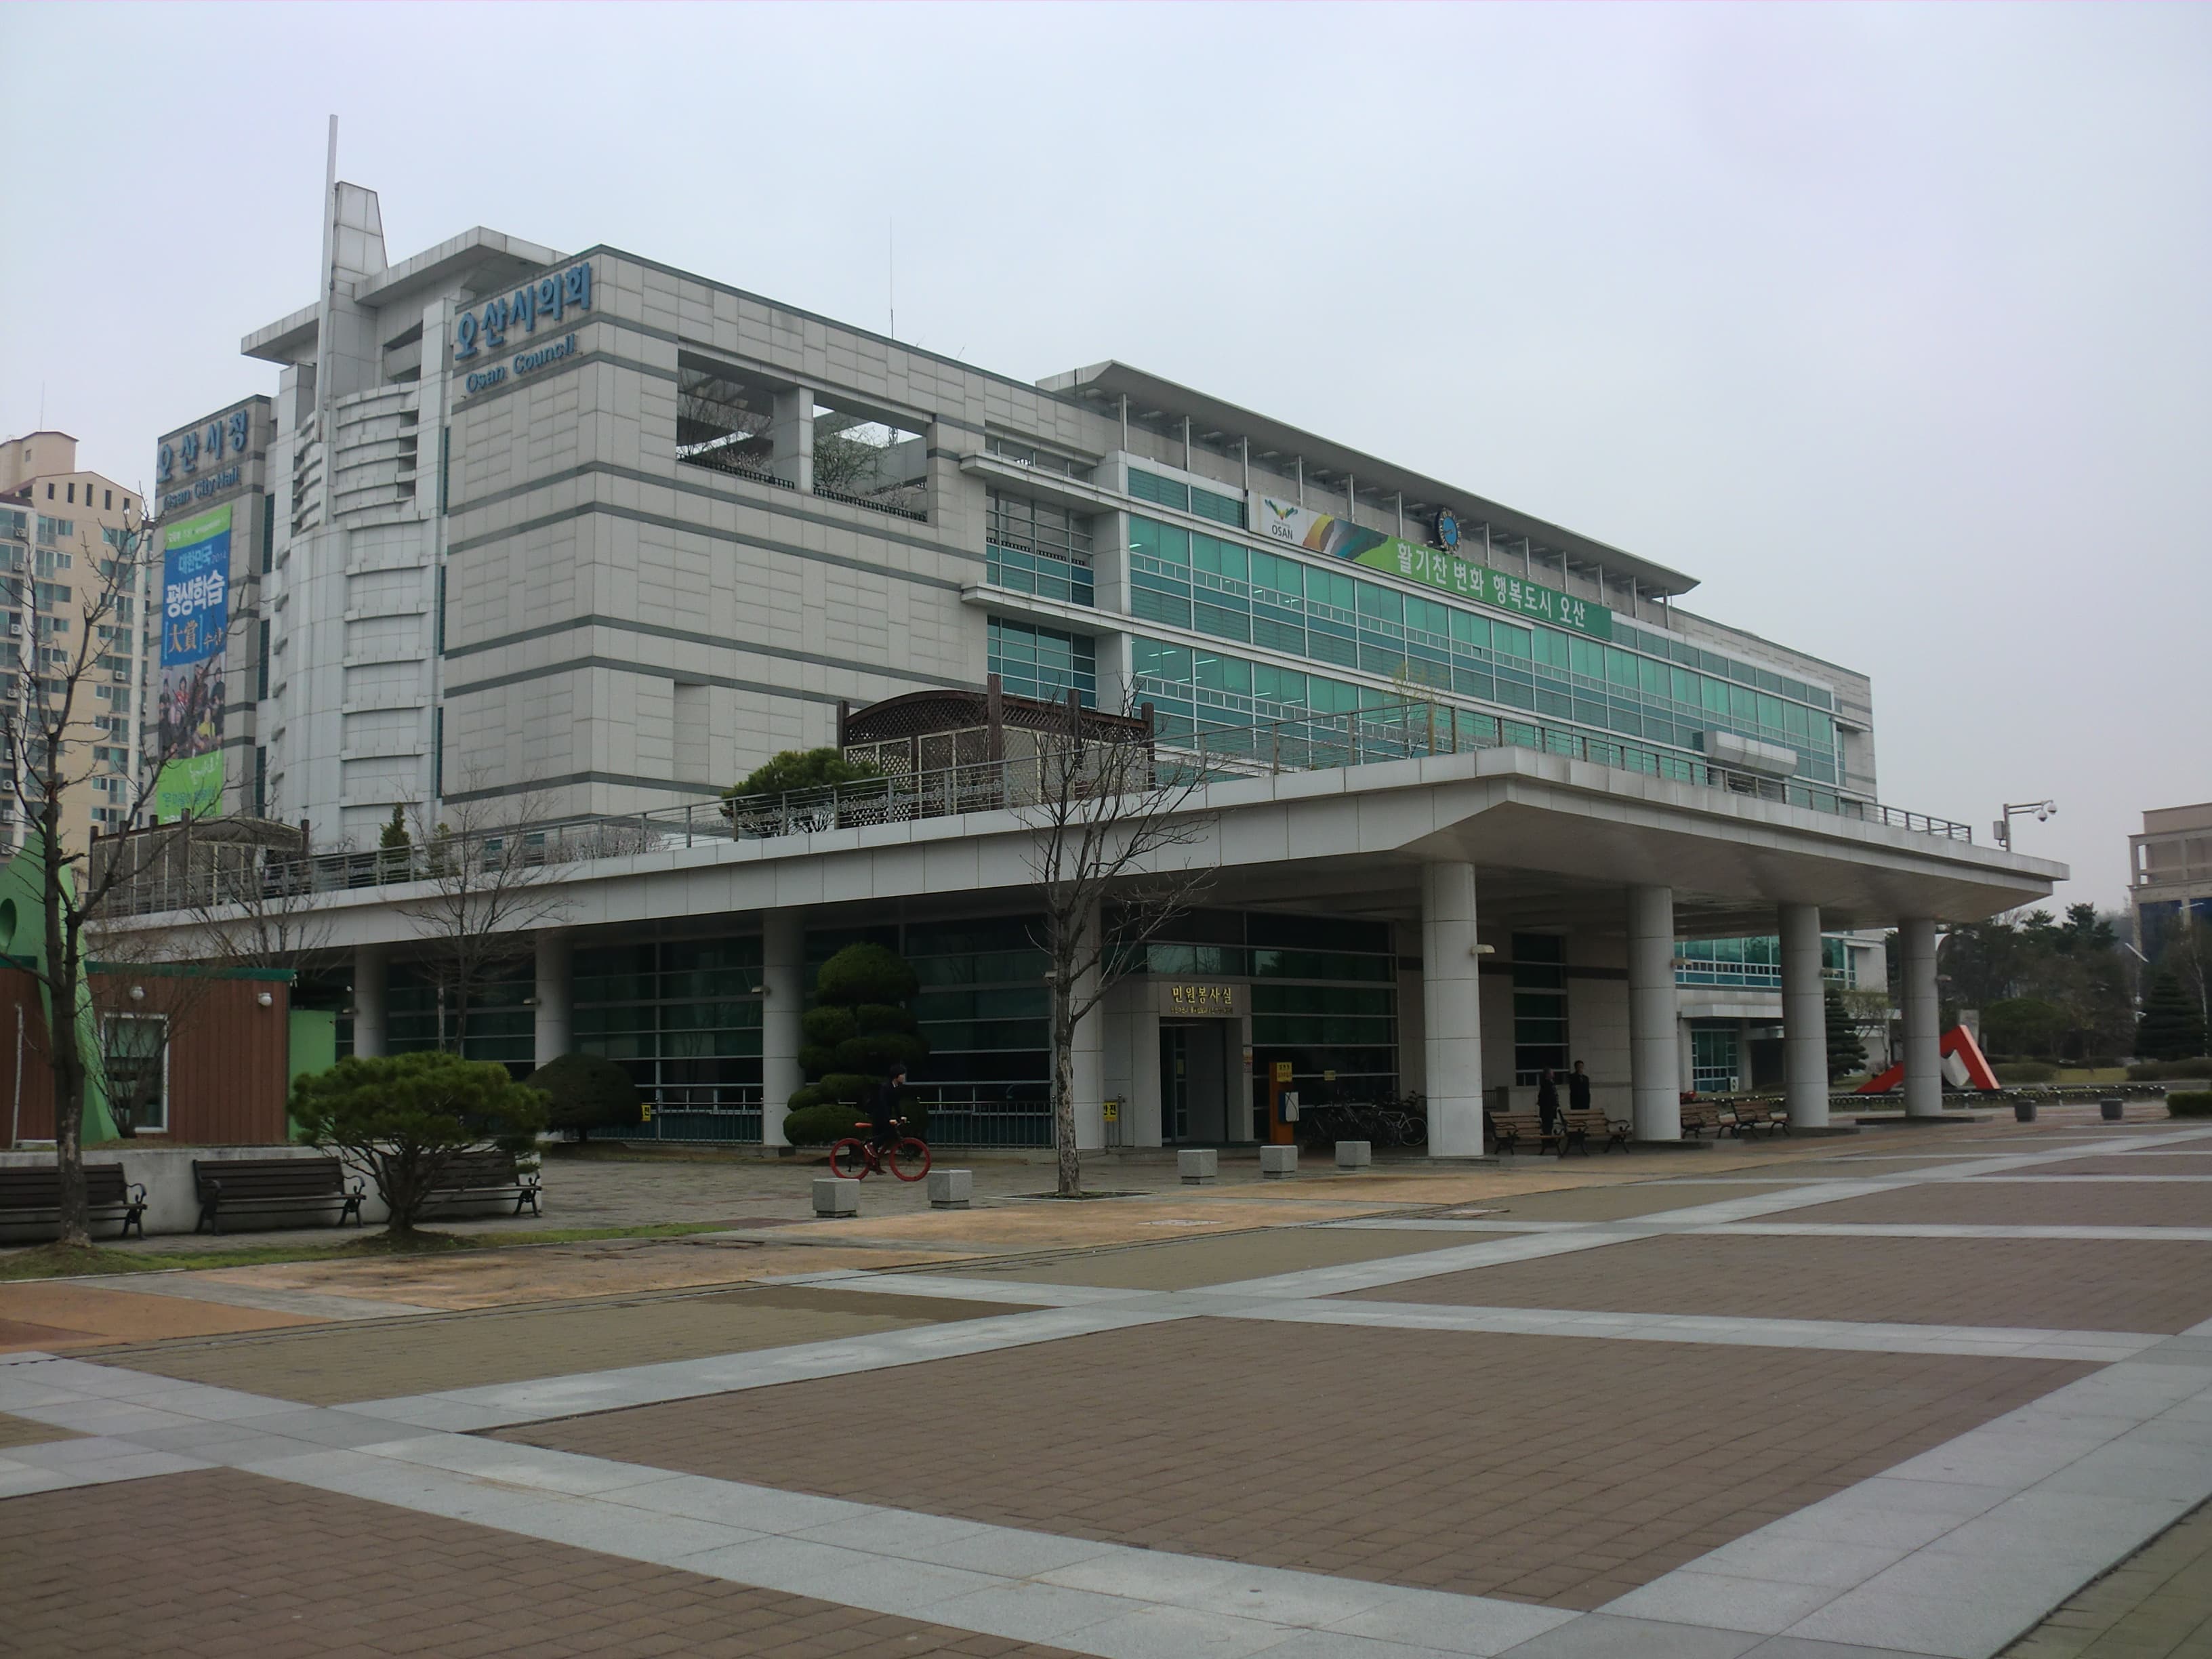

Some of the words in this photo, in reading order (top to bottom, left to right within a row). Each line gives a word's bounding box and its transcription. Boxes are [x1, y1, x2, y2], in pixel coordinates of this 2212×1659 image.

[455, 262, 592, 361] 오산시의회
[466, 366, 507, 393] Osan
[513, 333, 575, 374] Council
[157, 409, 247, 484] 오산시청
[163, 489, 191, 510] Osan
[193, 477, 216, 499] City
[216, 466, 239, 489] Hall
[1271, 524, 1293, 540] OSAN
[178, 544, 213, 575] 대한민국
[166, 569, 226, 618] 평생학습
[1397, 543, 1447, 585] 활기찬
[1453, 561, 1484, 597] 변화
[1493, 575, 1552, 619] 행복도시
[1559, 596, 1585, 628] 오산
[1172, 985, 1231, 1004] 민원봉사실
